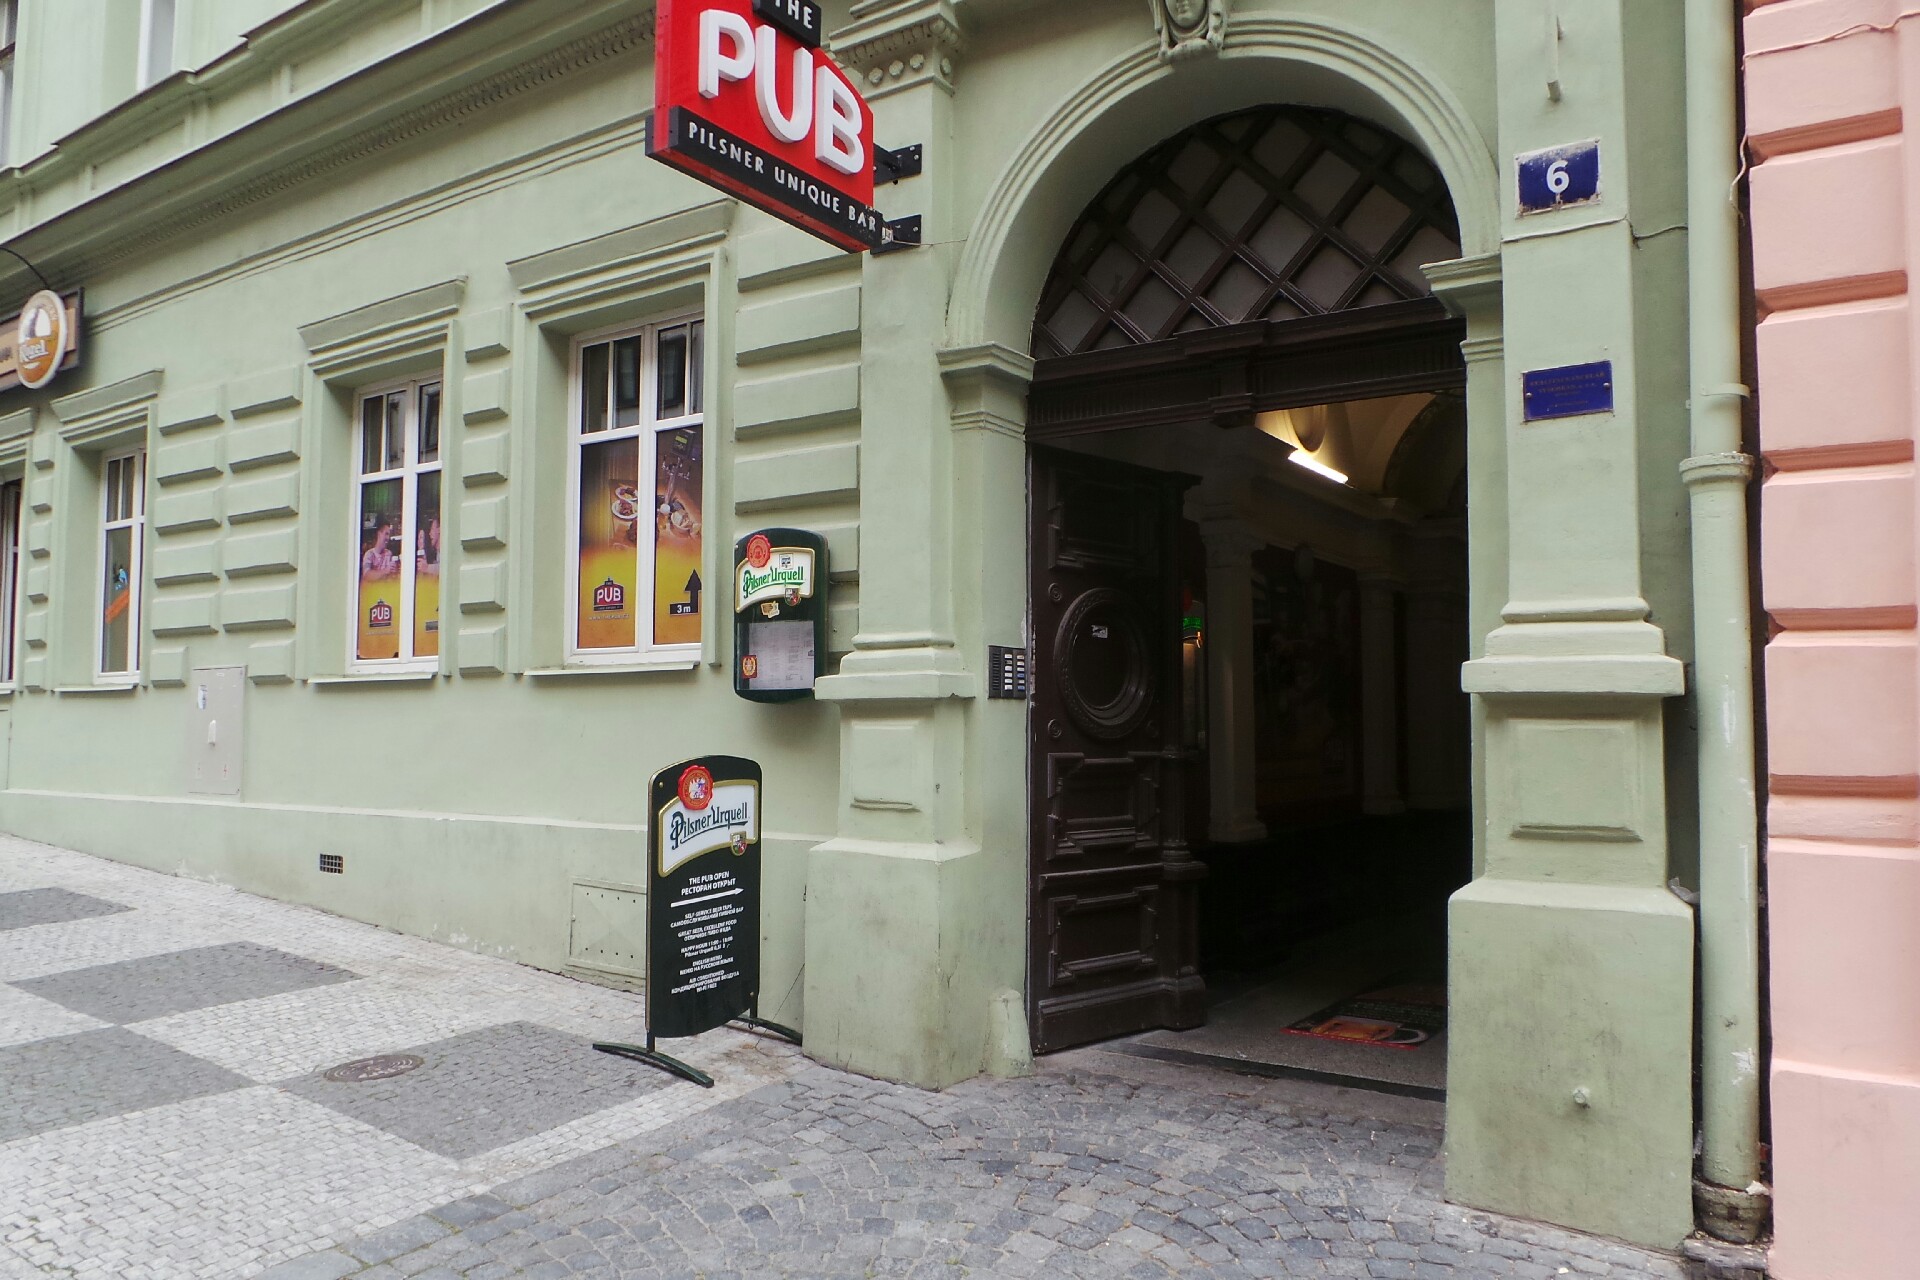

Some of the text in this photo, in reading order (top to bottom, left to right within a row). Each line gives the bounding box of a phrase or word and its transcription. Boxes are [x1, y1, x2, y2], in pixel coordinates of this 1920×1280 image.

[774, 0, 813, 30] THE
[698, 9, 865, 175] PUB
[688, 121, 876, 232] PILSNER UNIQUE BAR
[1546, 160, 1570, 194] 6
[596, 587, 621, 603] PUB
[742, 565, 804, 599] Pilsner Urquell
[371, 607, 390, 621] PUB
[676, 604, 691, 614] 3 m
[670, 802, 748, 850] Pilsner Urquell
[681, 878, 736, 895] РЕСТОРАН ОТКРЫТ
[689, 871, 729, 885] THE PUB OPEN
